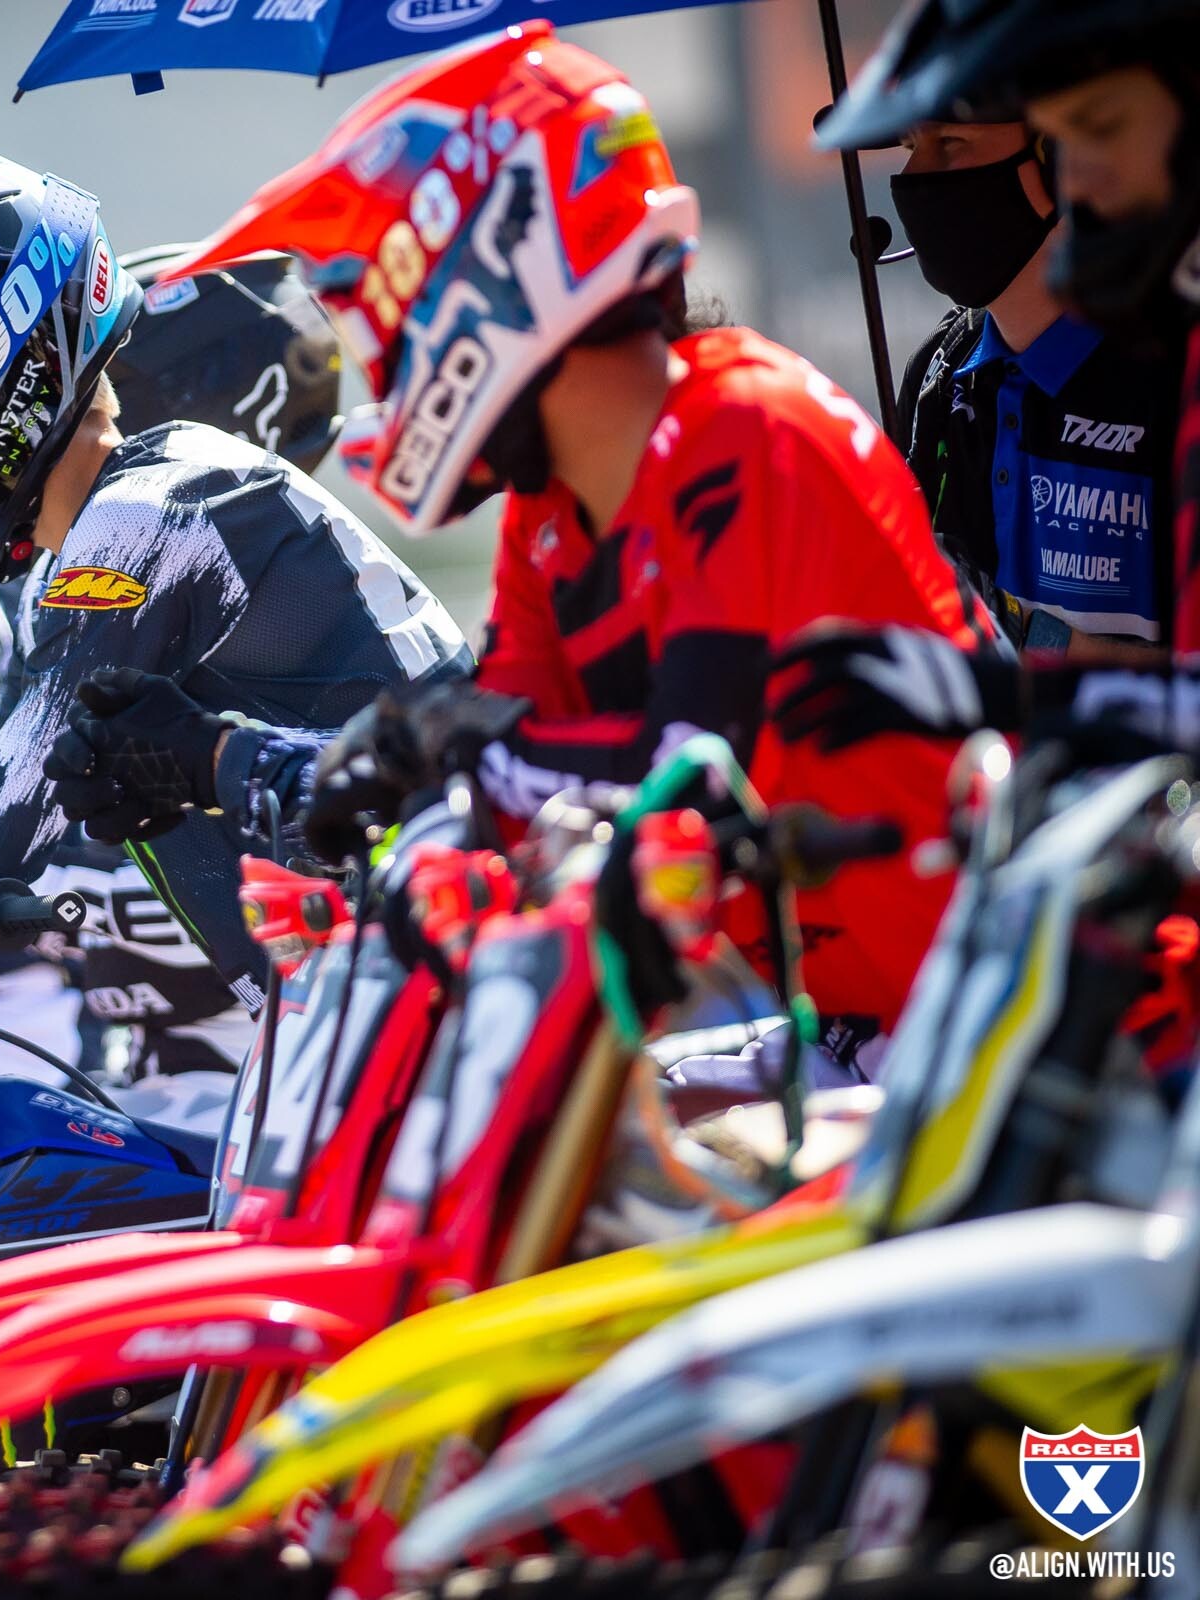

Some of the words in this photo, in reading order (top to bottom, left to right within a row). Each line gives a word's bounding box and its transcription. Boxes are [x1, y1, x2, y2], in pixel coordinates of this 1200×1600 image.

[92, 250, 109, 306] BELL
[1, 384, 51, 476] ENERGY
[1060, 413, 1145, 453] THOR
[1040, 547, 1121, 583] YAMALUBE
